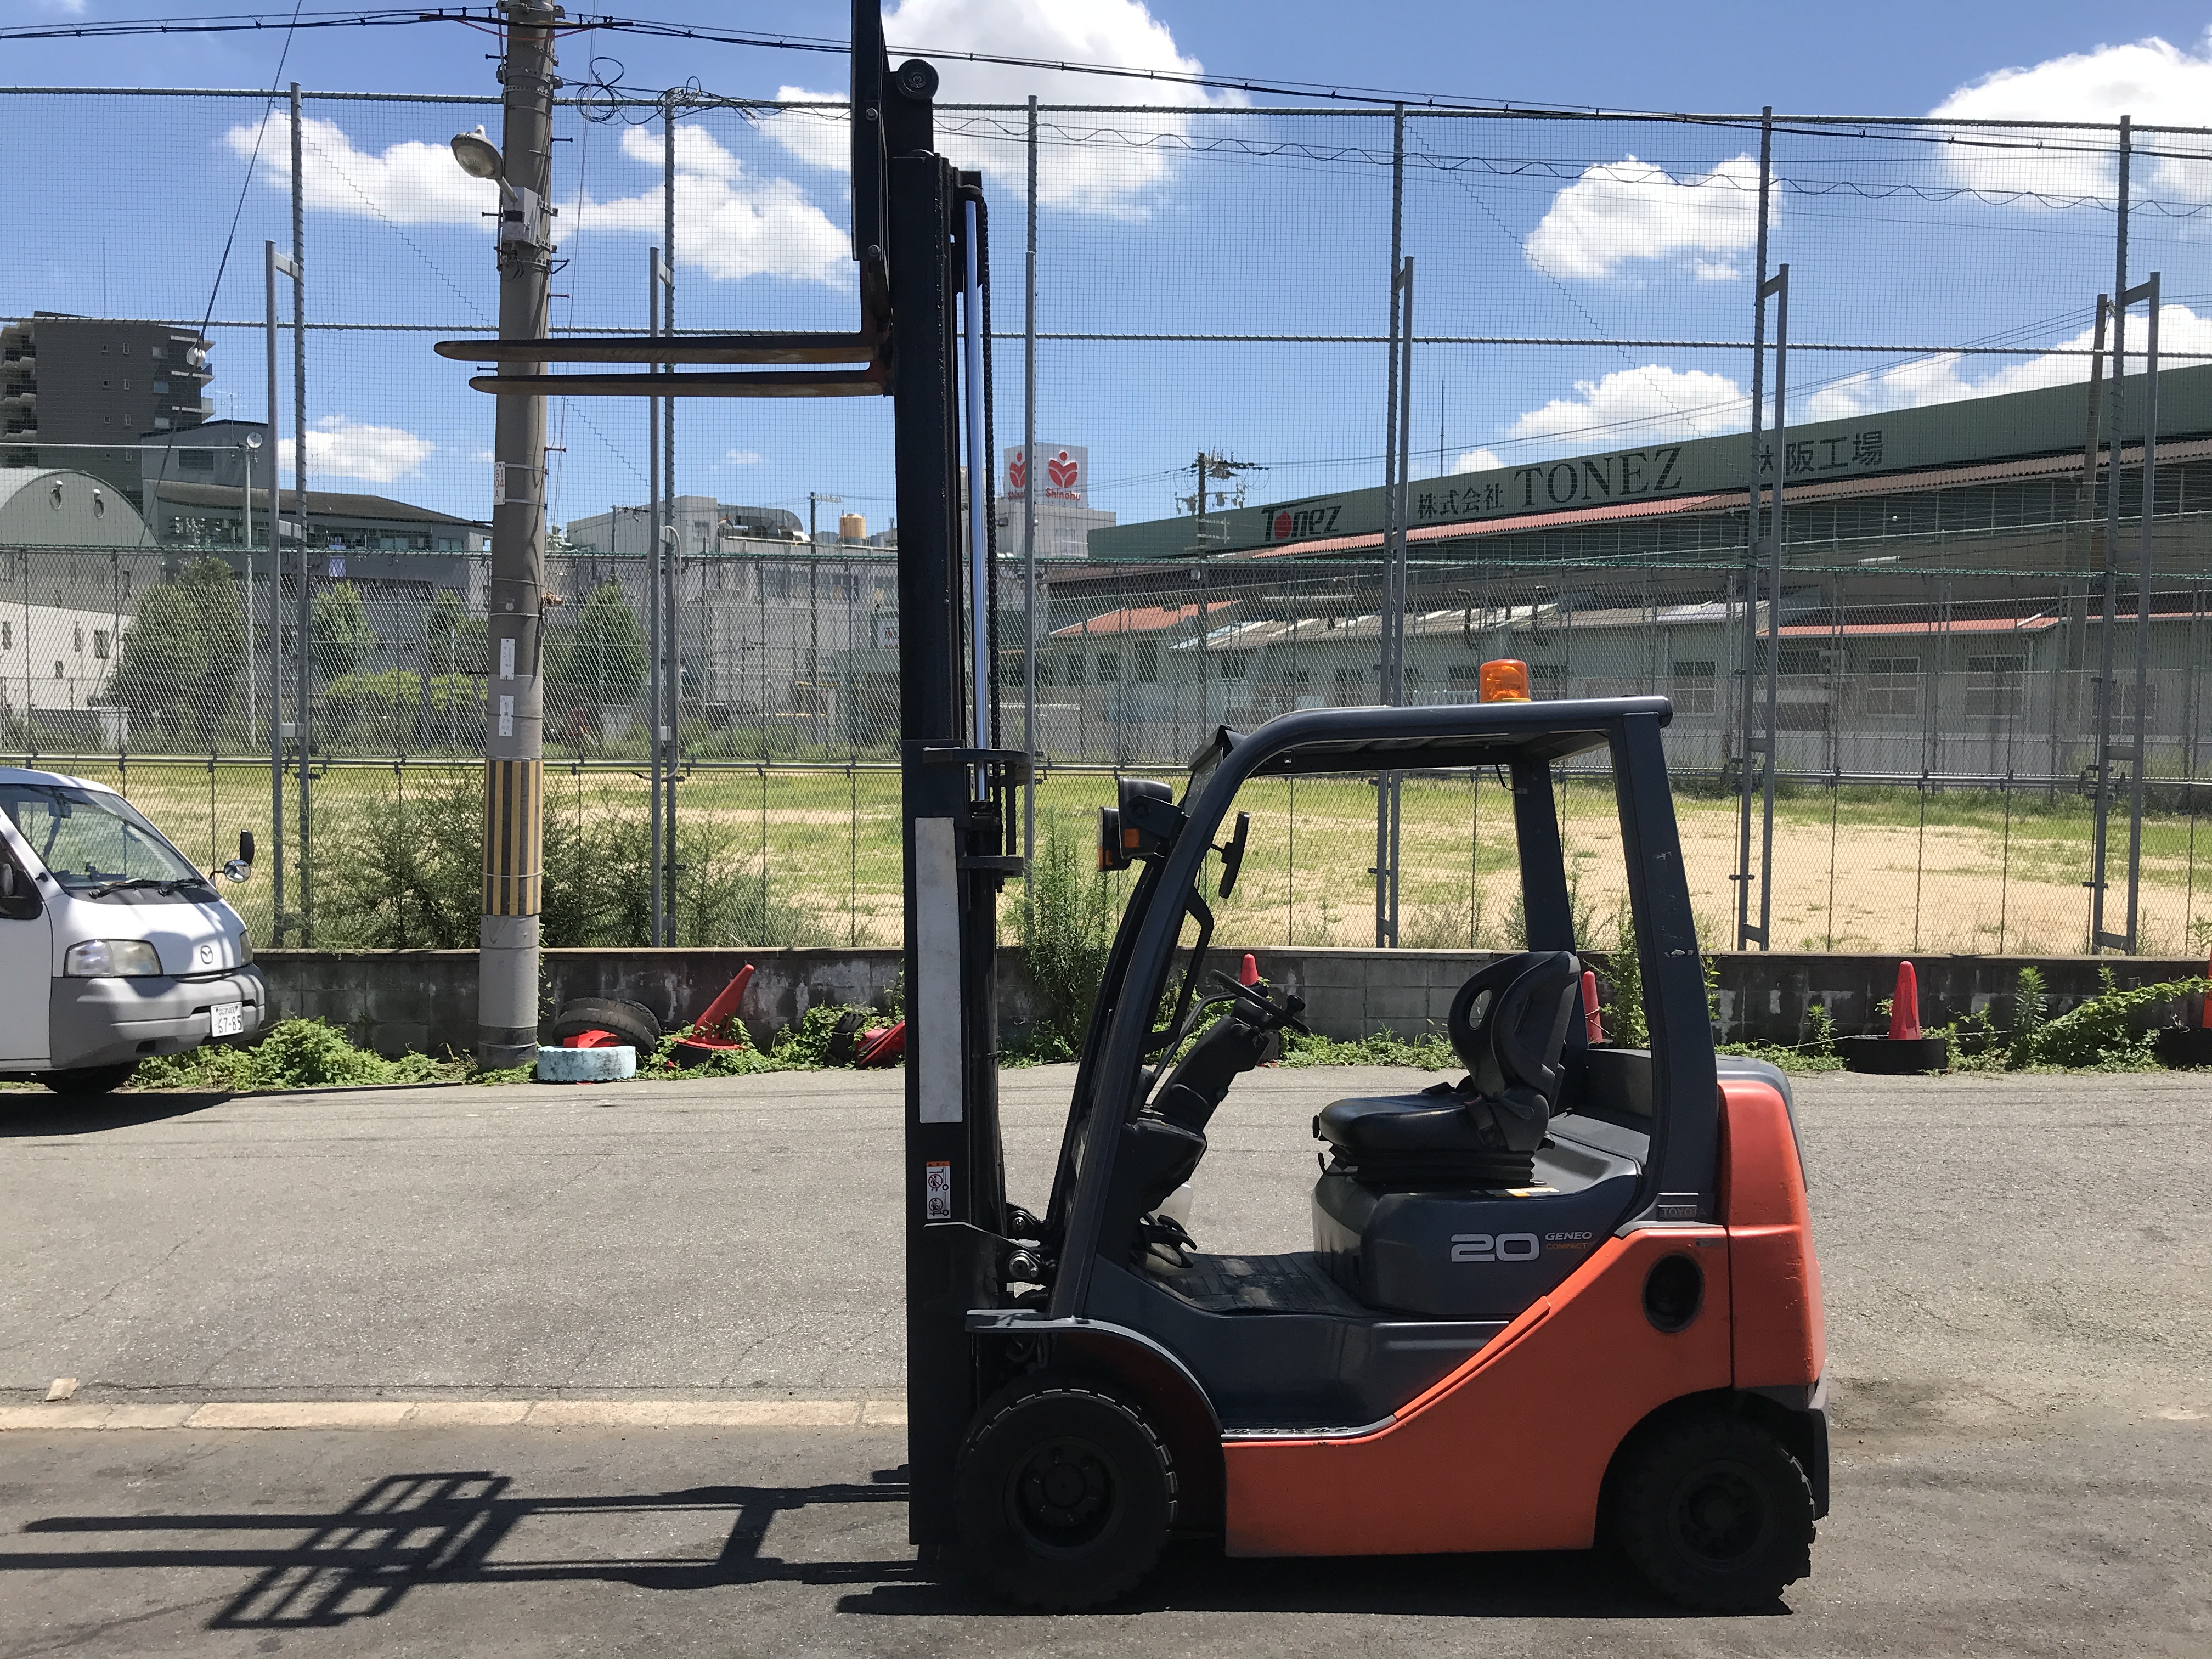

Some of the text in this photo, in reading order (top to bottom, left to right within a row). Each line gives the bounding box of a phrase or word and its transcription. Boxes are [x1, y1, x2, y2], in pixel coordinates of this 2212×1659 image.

[1418, 430, 1884, 520] 株式会社 TONEZ 大阪工場
[1045, 487, 1081, 501] Shinobu
[1662, 1207, 1706, 1216] TOYOTA
[1545, 1231, 1593, 1240] GENEO
[1451, 1232, 1540, 1262] 20
